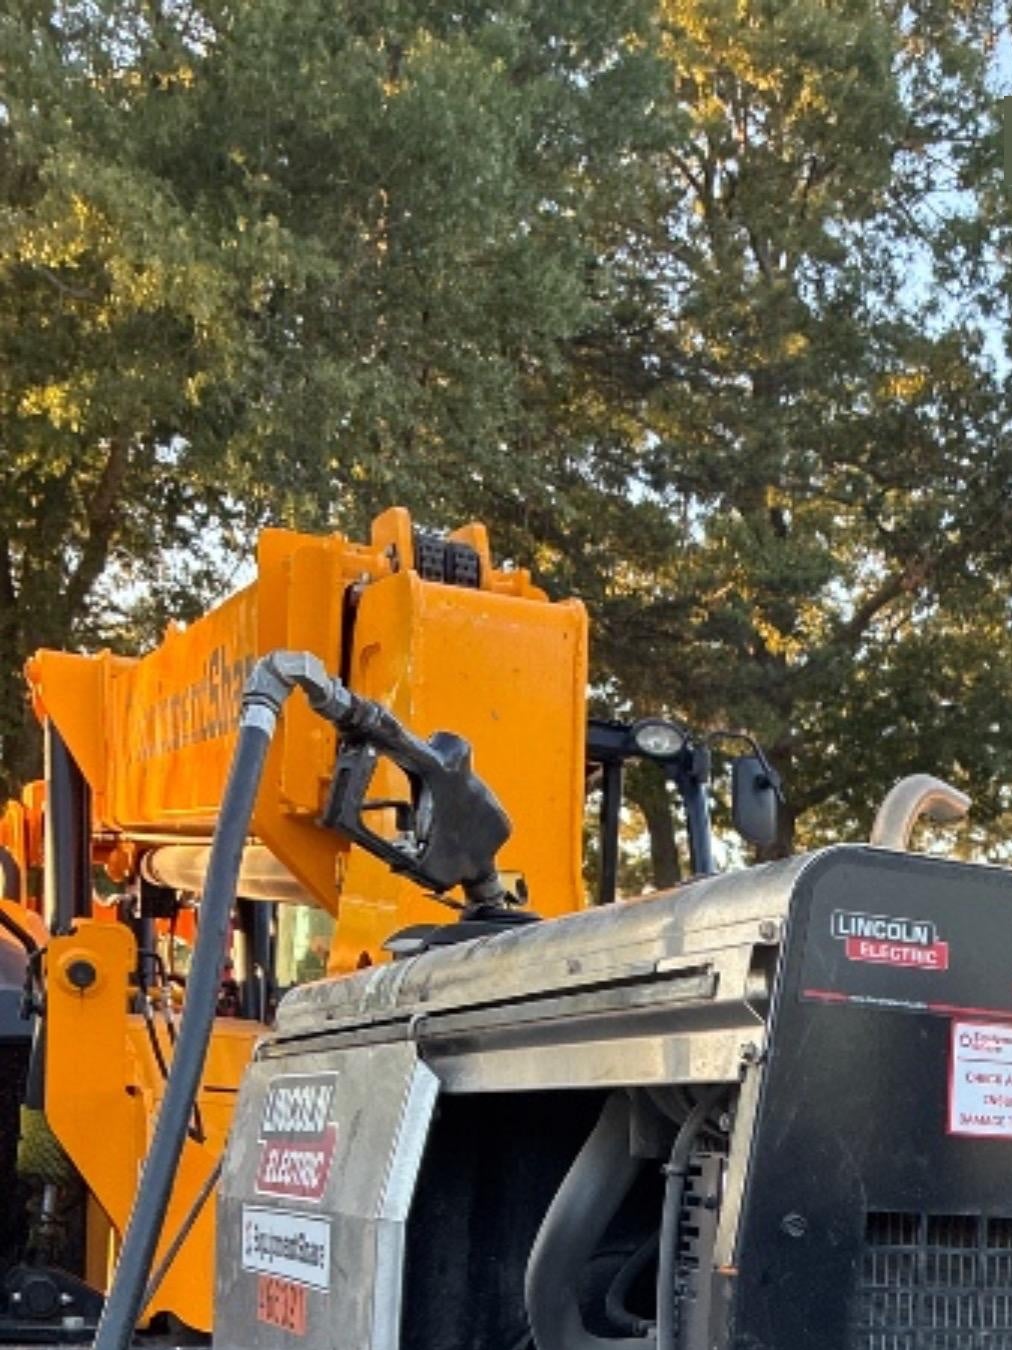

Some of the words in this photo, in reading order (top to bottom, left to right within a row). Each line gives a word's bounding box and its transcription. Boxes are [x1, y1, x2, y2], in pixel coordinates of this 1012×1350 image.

[839, 914, 929, 946] LINCOLN
[859, 942, 938, 965] ELECTRIC
[263, 1085, 333, 1131] LINCOLN
[264, 1148, 325, 1188] ELECTRIC
